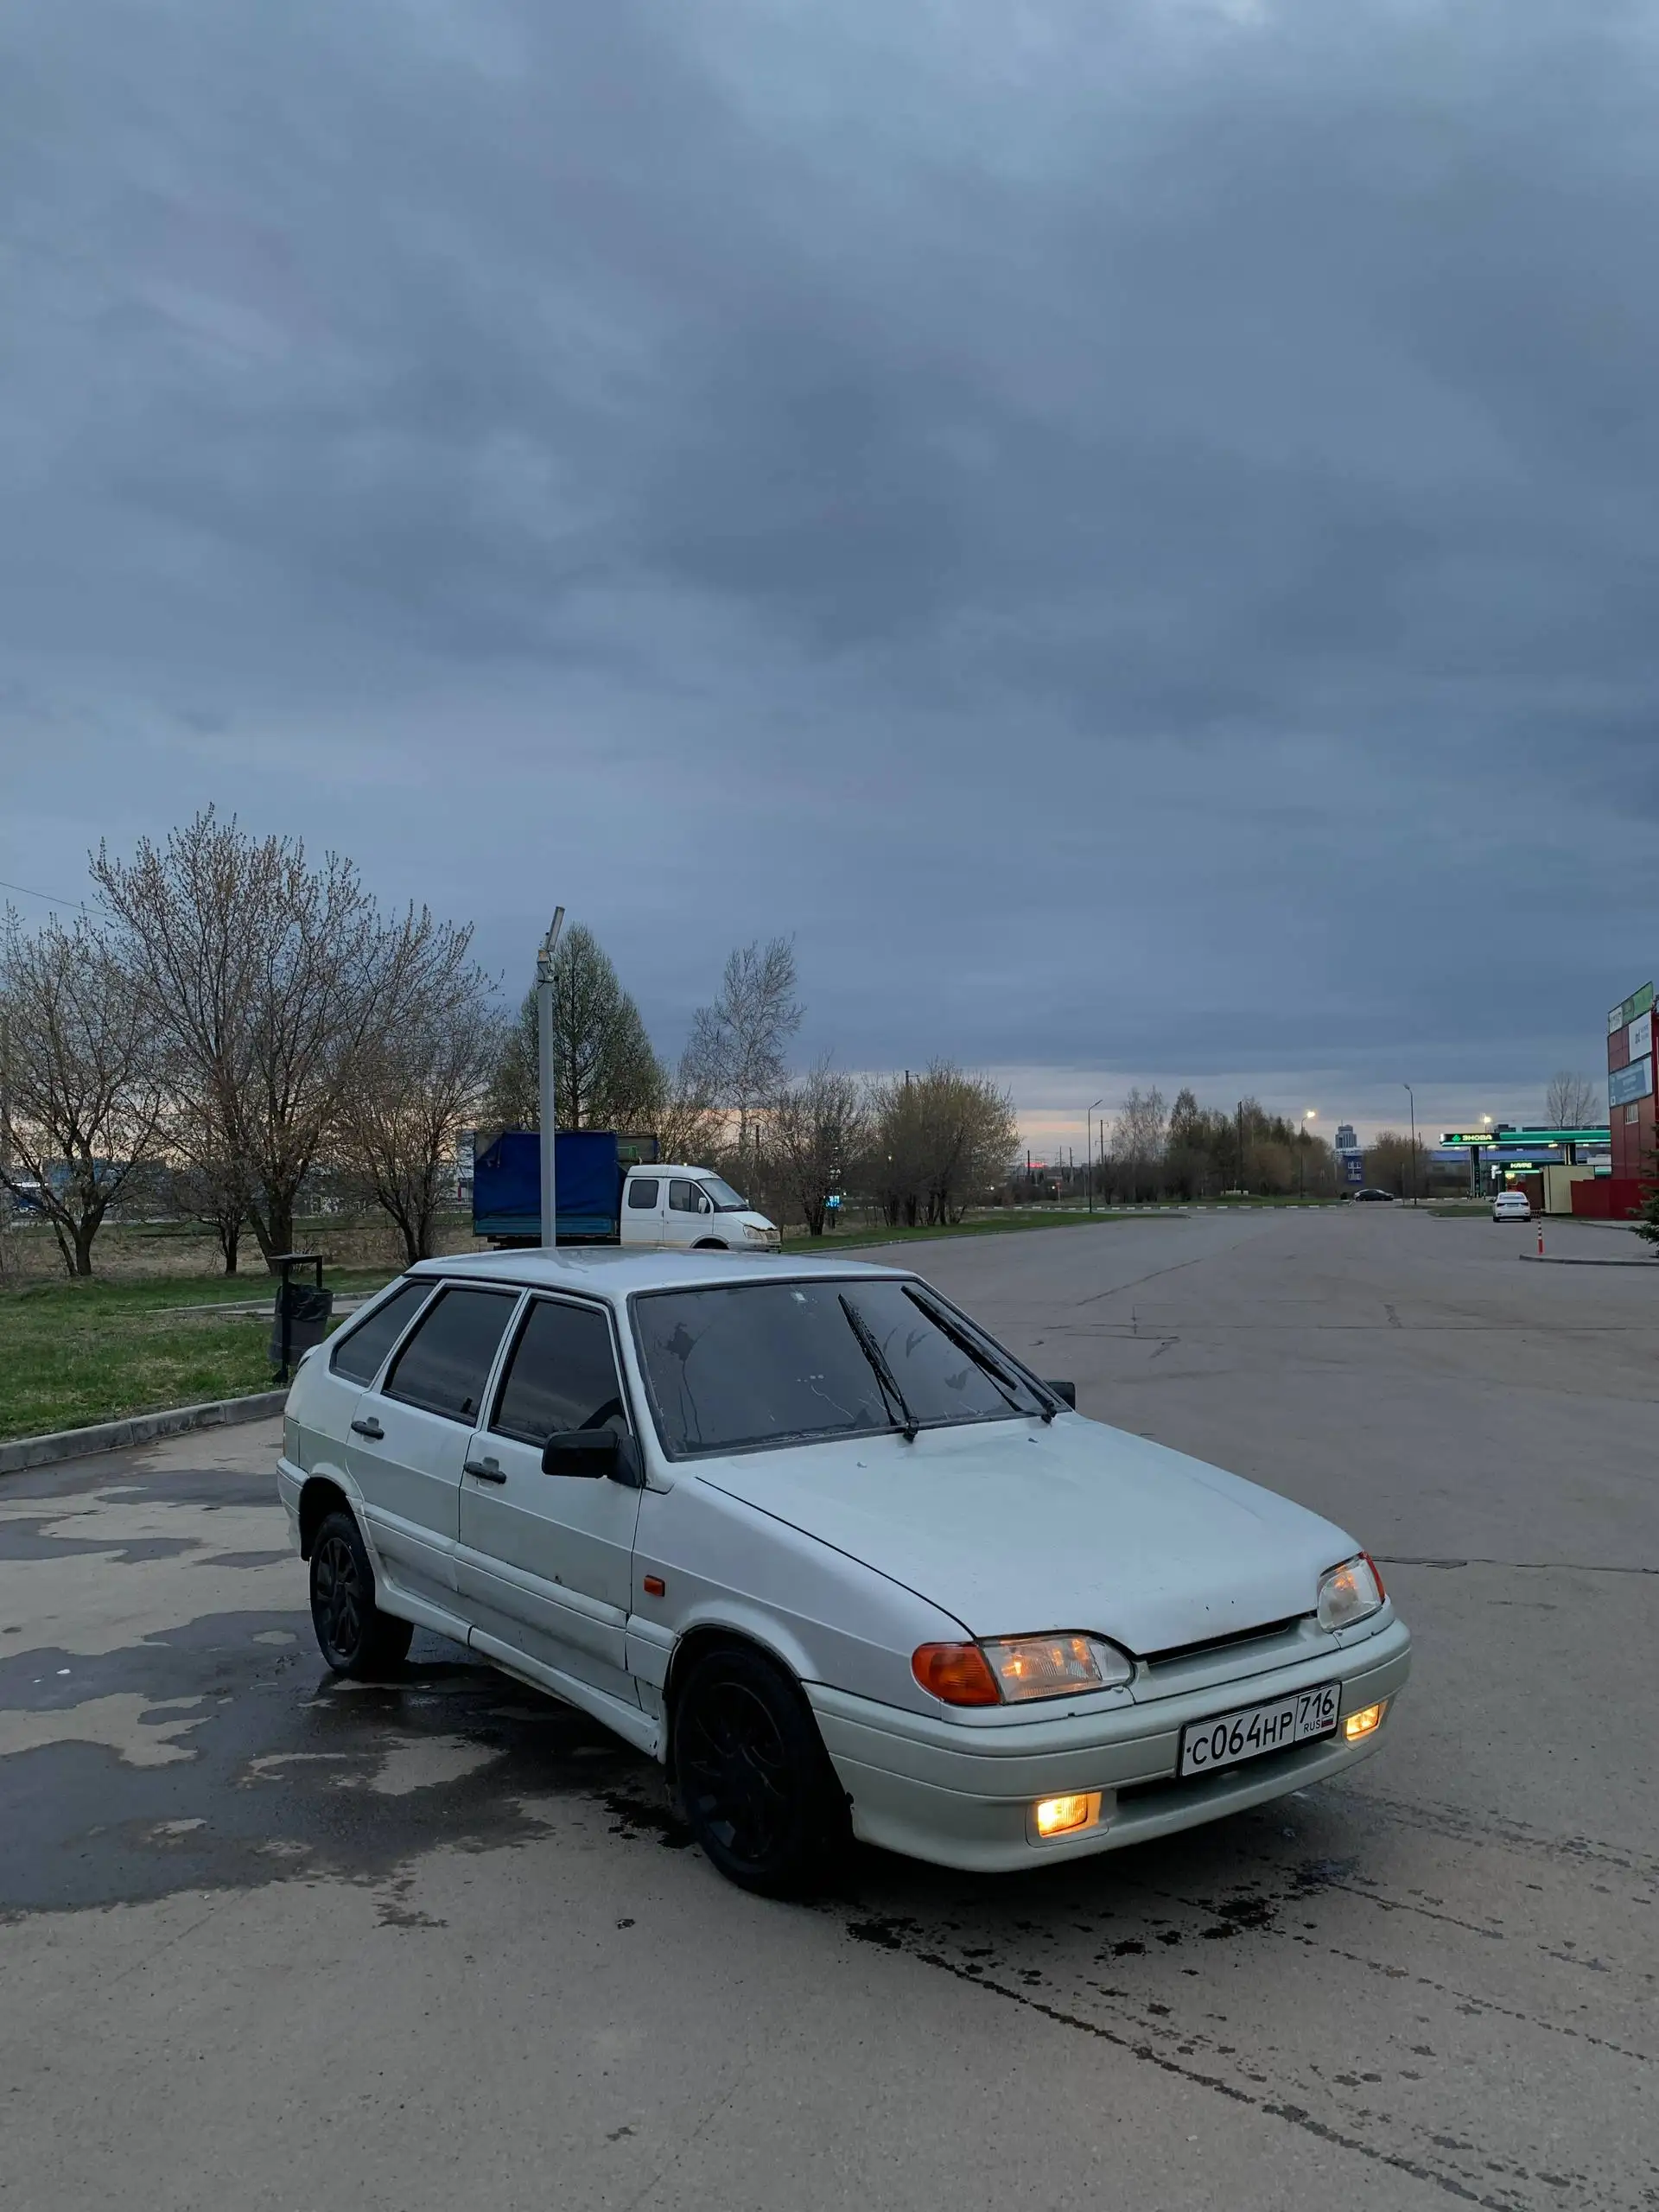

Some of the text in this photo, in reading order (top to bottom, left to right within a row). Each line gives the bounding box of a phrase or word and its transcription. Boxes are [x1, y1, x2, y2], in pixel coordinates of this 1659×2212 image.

[1192, 1690, 1334, 1764] С064НР 716
[1303, 1719, 1321, 1733] RUS
